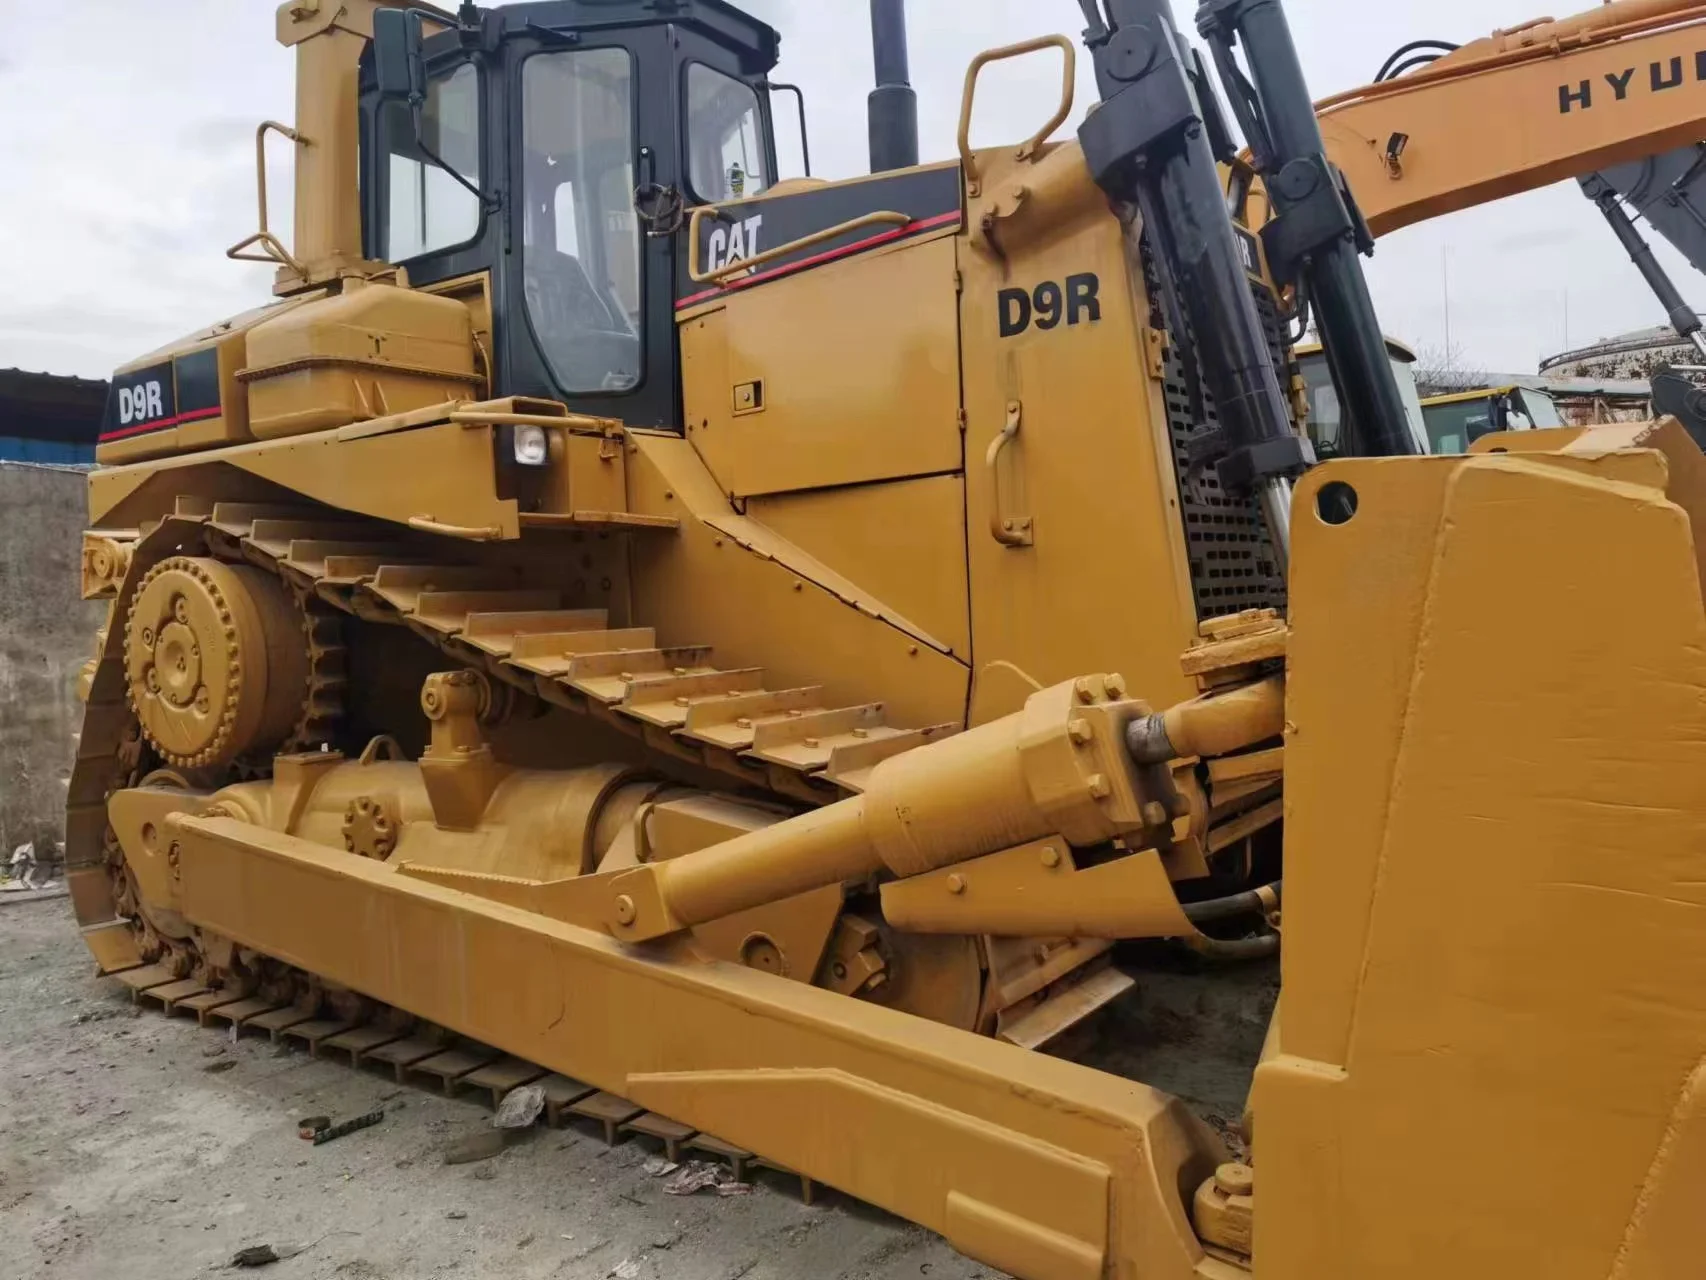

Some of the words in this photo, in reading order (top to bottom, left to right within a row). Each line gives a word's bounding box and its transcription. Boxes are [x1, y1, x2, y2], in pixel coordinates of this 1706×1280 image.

[707, 213, 763, 274] CAT
[997, 271, 1102, 338] D9R
[118, 380, 163, 424] D9R
